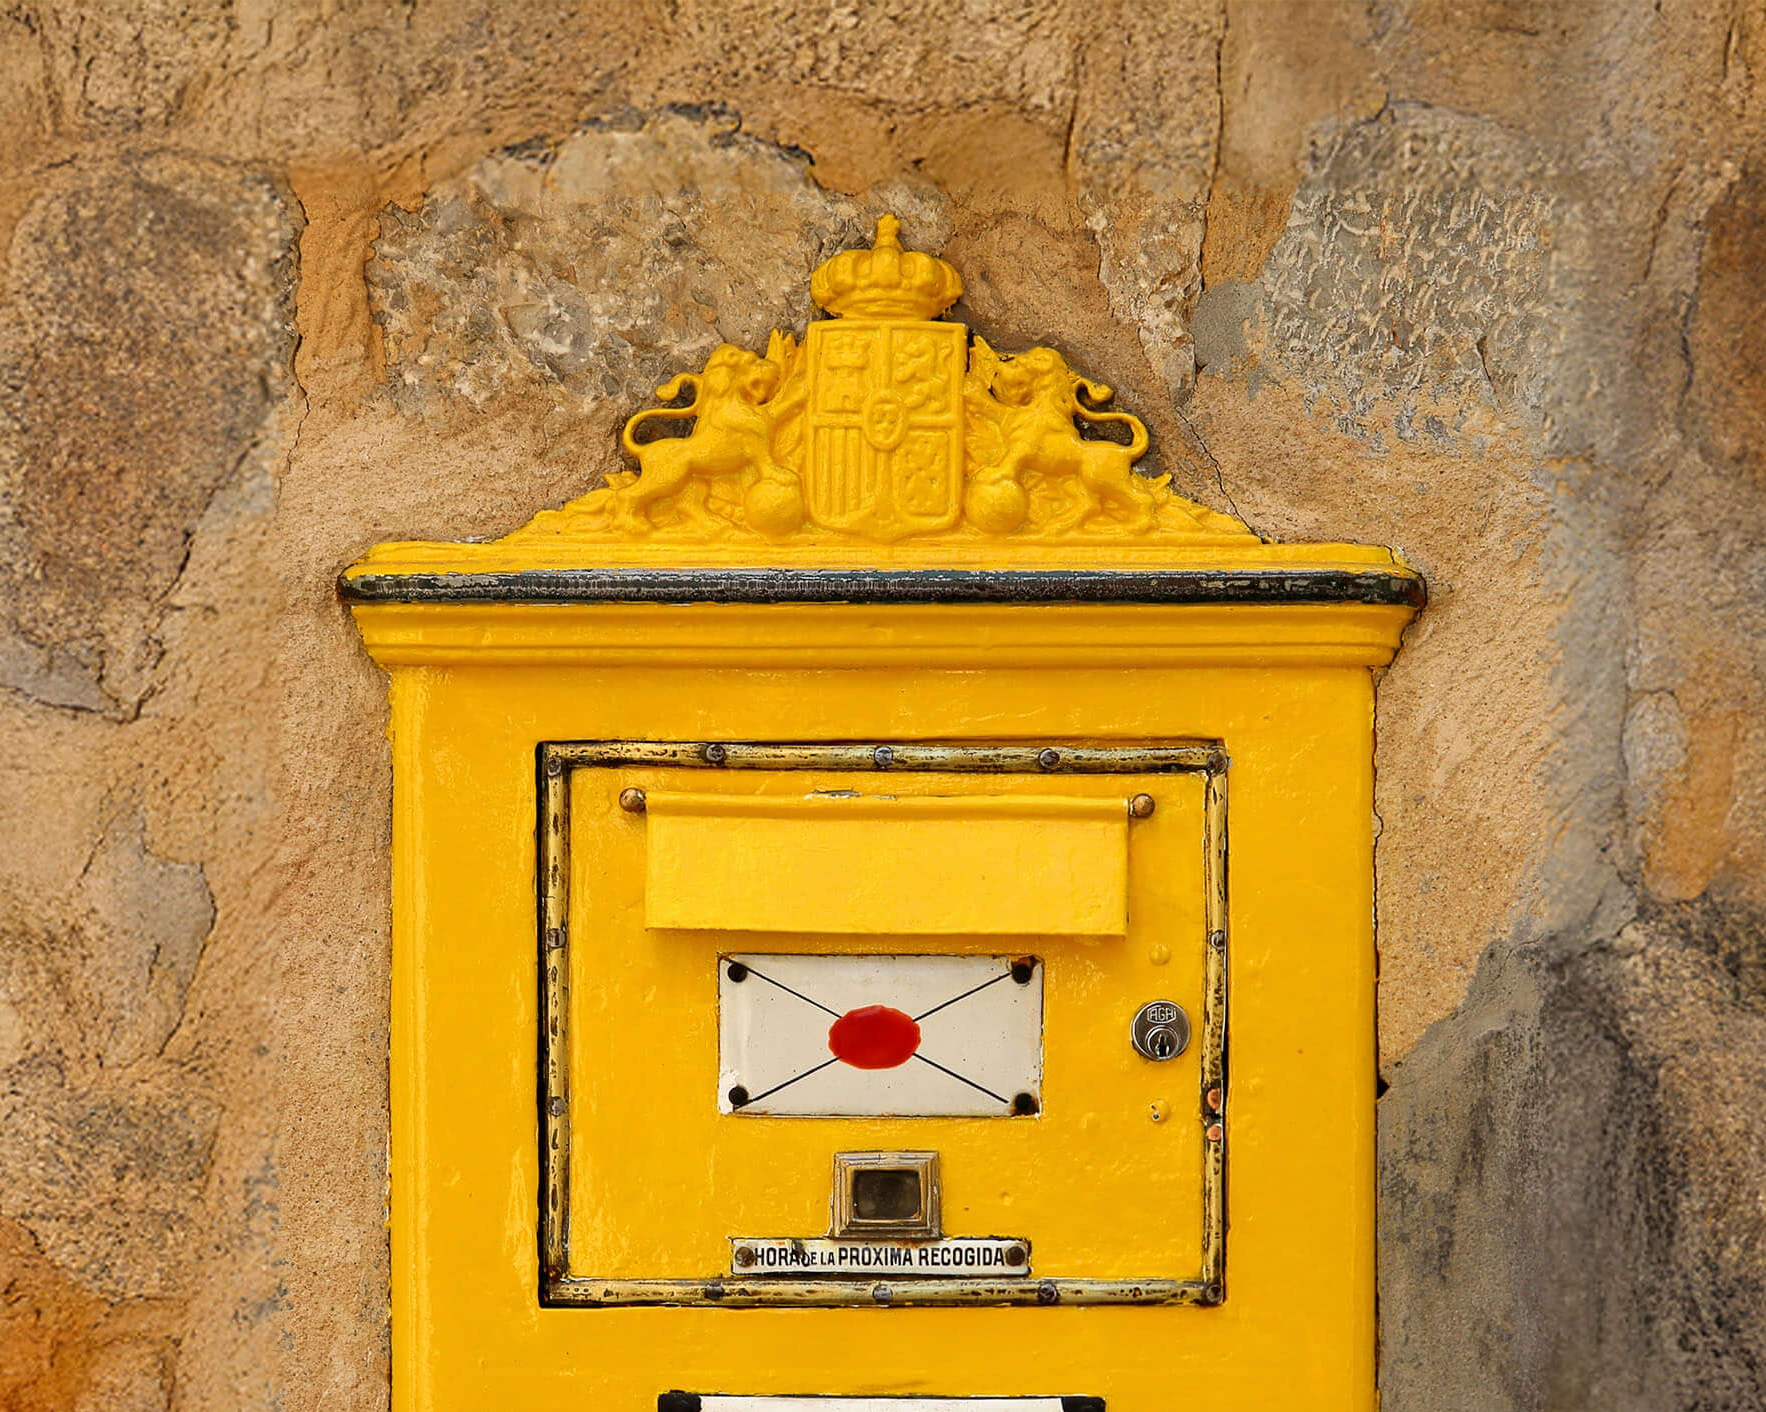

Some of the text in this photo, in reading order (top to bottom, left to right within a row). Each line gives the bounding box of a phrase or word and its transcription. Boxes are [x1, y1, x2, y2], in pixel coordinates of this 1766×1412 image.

[1149, 1007, 1174, 1021] AGA
[754, 1247, 800, 1267] HORA
[820, 1251, 835, 1266] LA
[918, 1247, 1005, 1267] RECOGIDA
